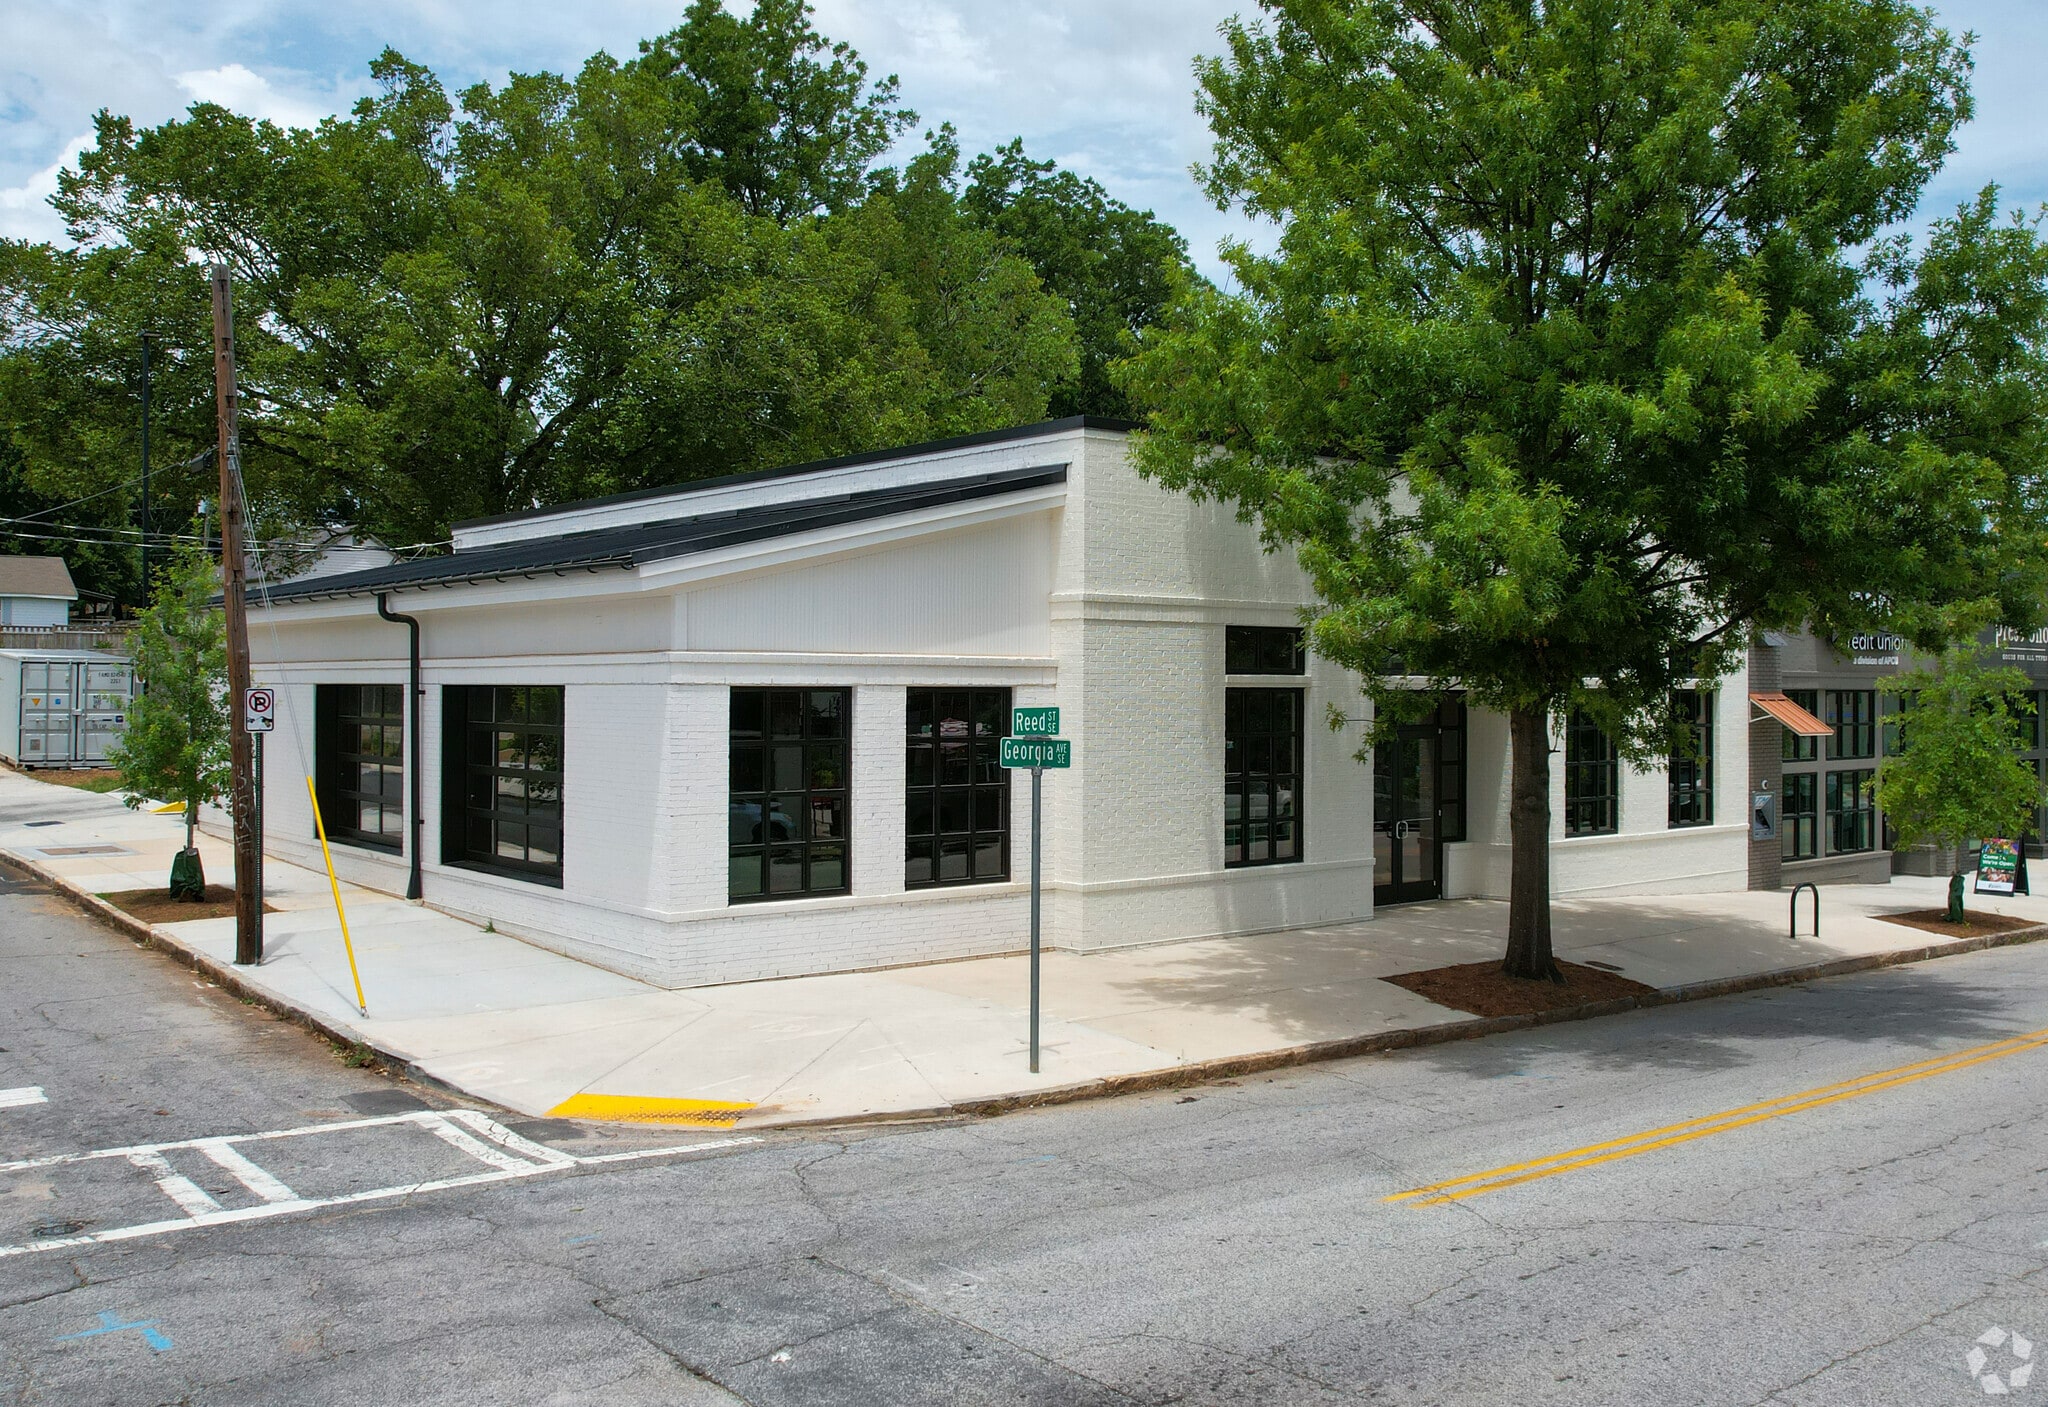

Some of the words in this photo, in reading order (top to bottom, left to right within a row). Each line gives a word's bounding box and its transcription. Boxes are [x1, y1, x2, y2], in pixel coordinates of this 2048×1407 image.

[1016, 712, 1046, 731] Reed
[1048, 711, 1056, 722] ST
[1047, 722, 1056, 733] SE
[1004, 740, 1054, 767] Georgia
[1055, 743, 1067, 753] AVE
[1057, 754, 1065, 764] SE
